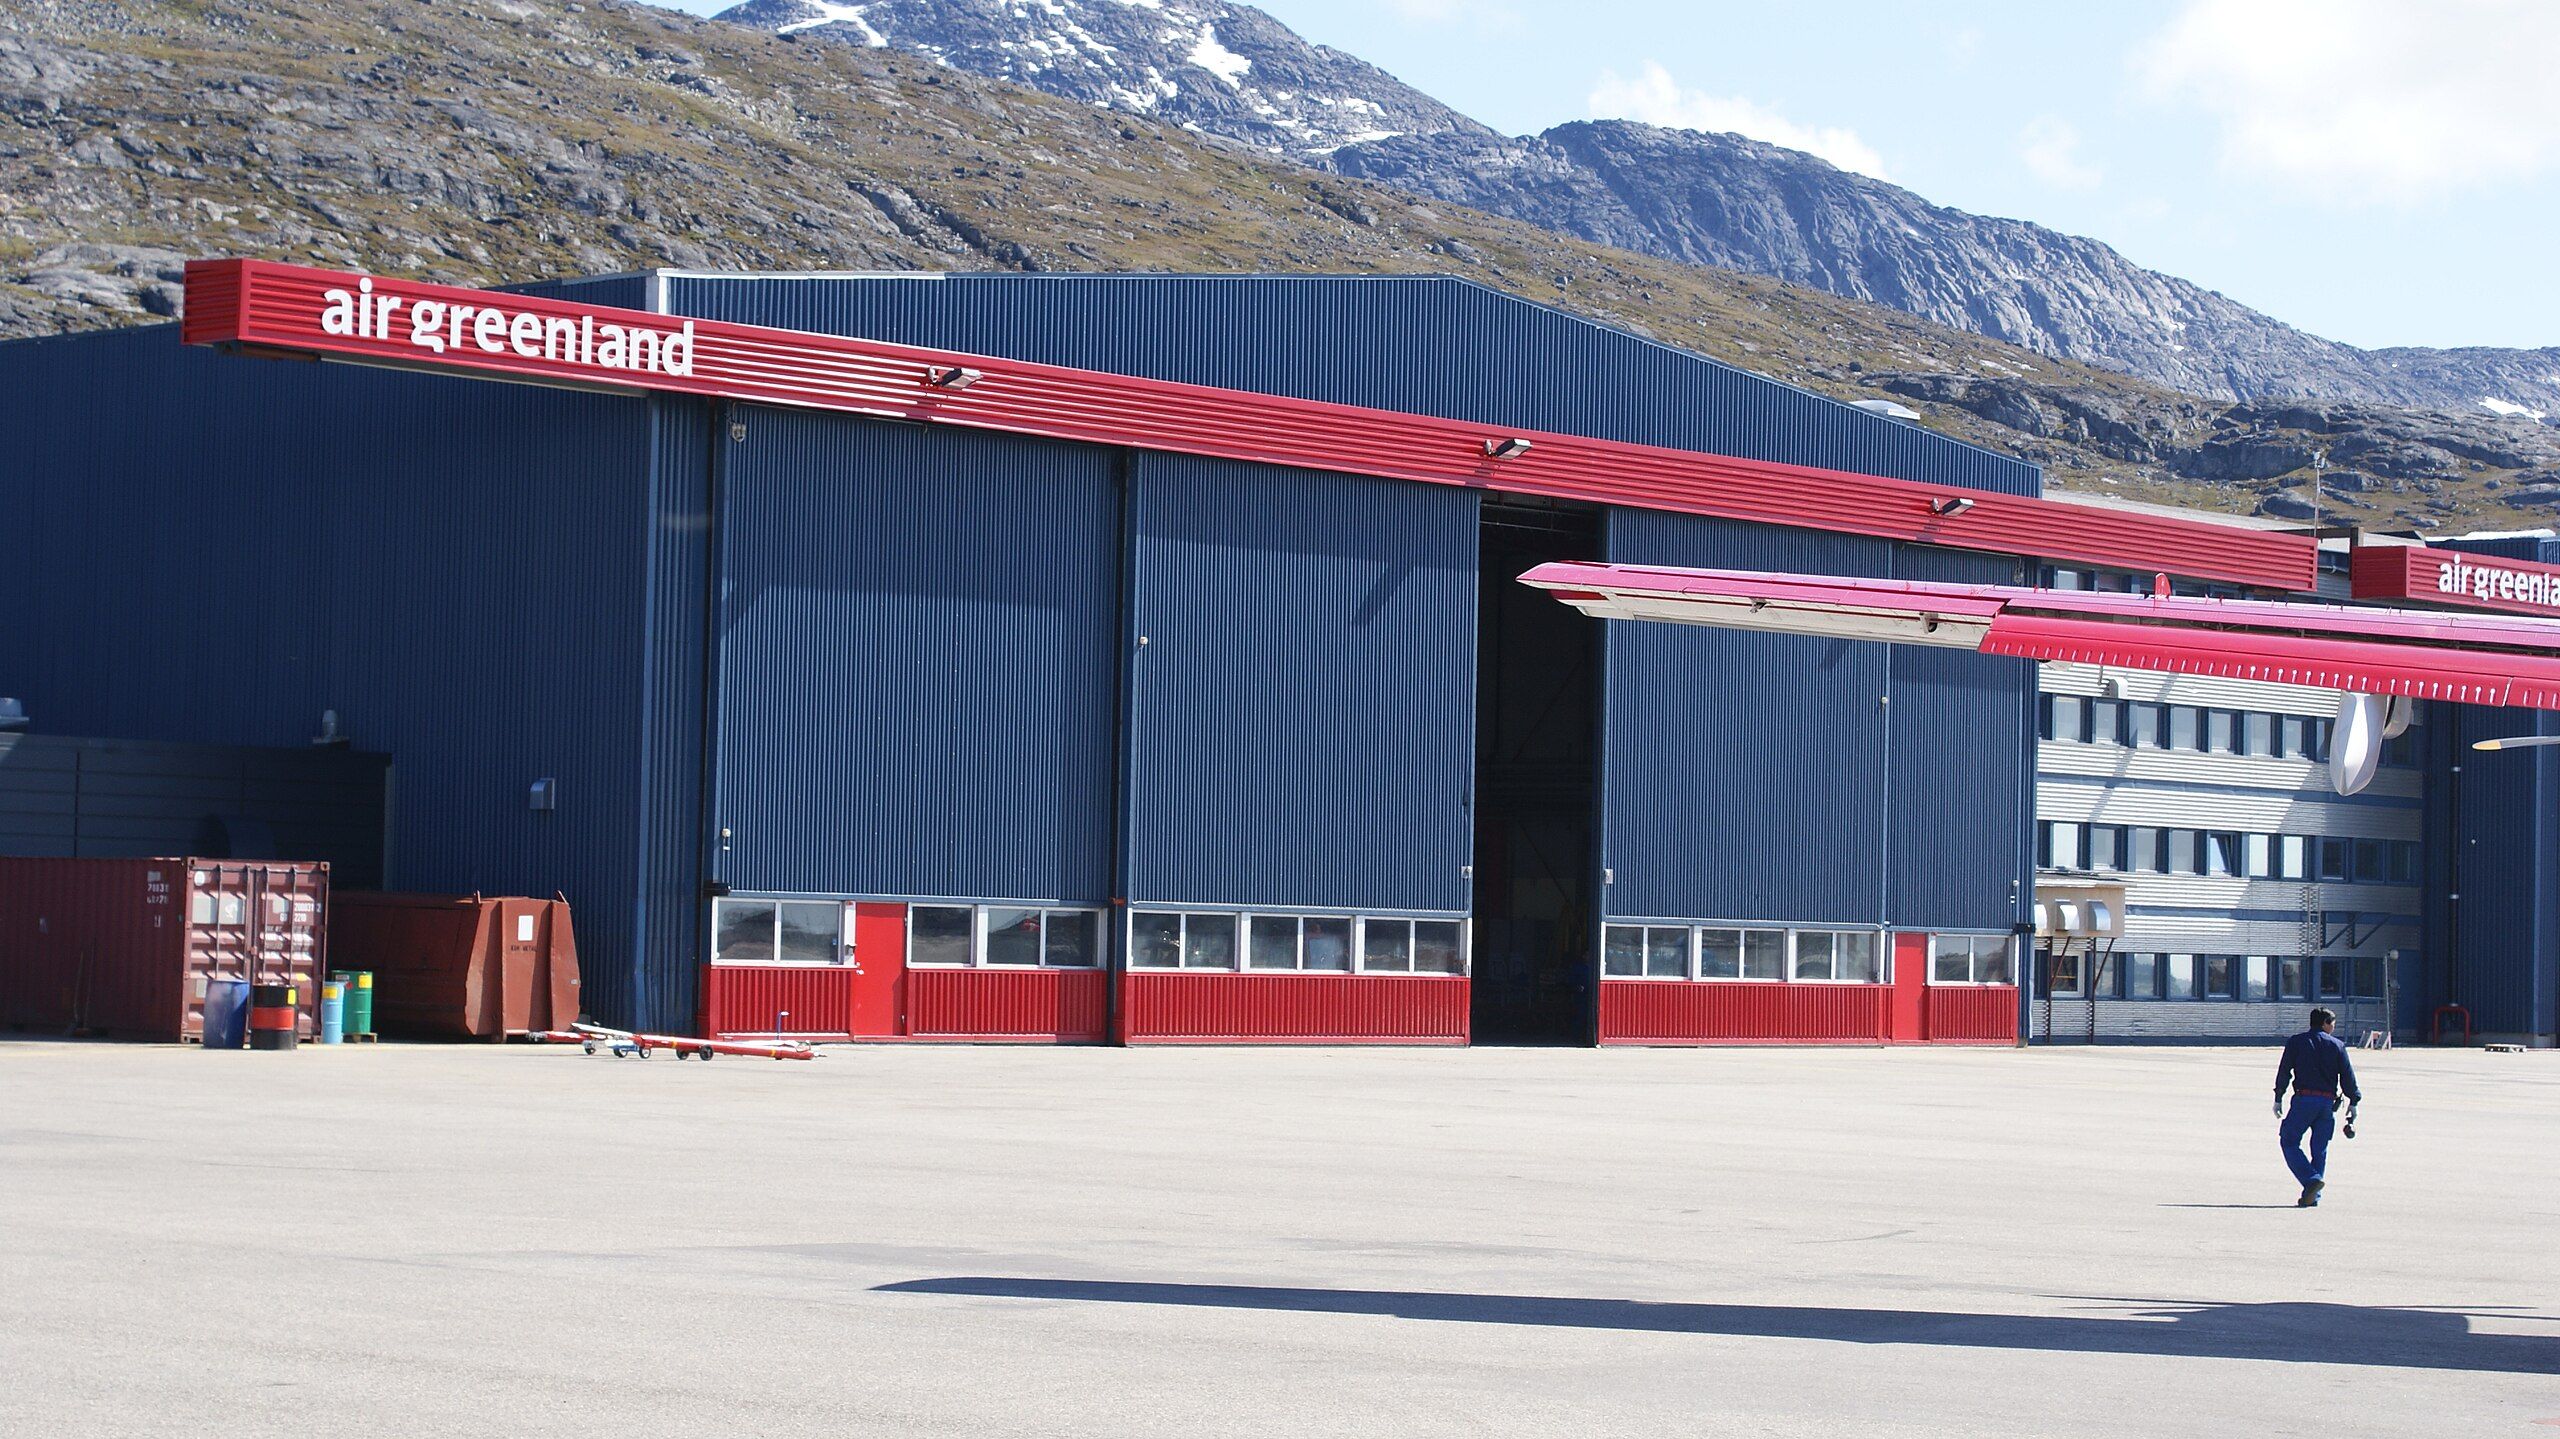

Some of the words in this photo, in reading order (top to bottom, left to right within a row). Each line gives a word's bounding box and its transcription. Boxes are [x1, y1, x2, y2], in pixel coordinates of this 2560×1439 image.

[321, 277, 401, 339] air
[410, 300, 694, 377] greenland
[2438, 553, 2472, 594] air
